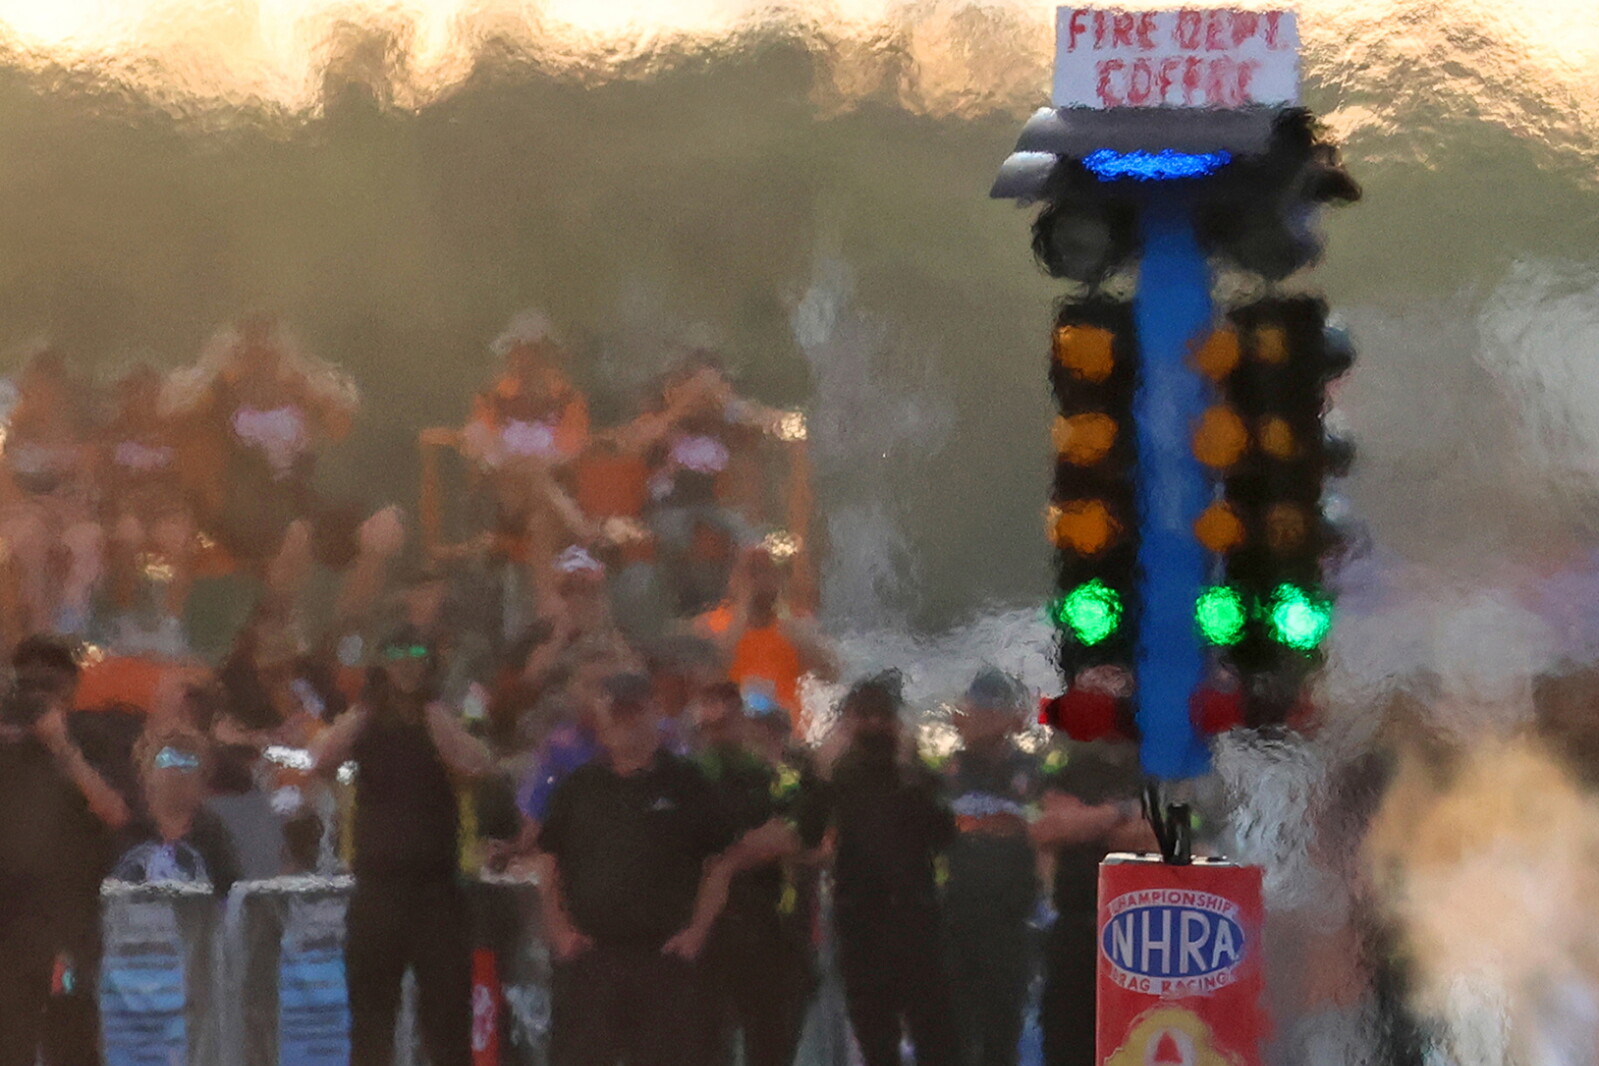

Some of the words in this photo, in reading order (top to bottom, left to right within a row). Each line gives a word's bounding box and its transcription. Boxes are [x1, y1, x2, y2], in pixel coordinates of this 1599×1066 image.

[1067, 8, 1157, 52] FIRE
[1111, 891, 1233, 914] CHAMPIONSHIP
[1112, 909, 1236, 974] NHRA
